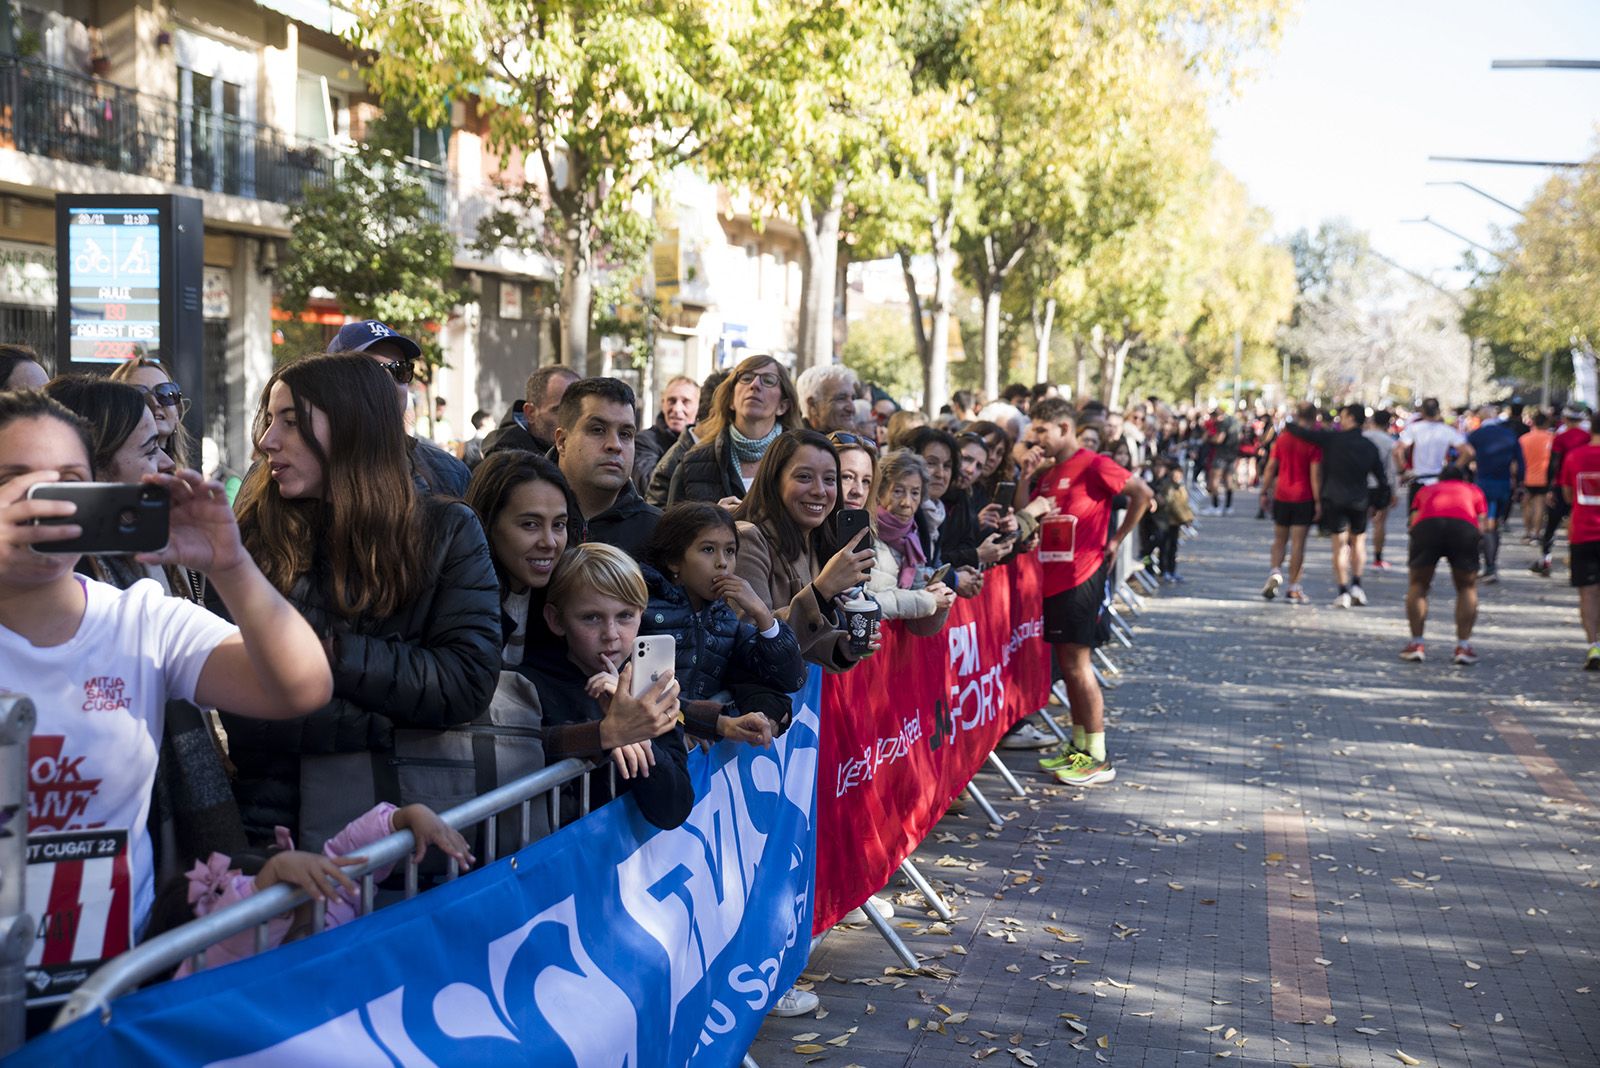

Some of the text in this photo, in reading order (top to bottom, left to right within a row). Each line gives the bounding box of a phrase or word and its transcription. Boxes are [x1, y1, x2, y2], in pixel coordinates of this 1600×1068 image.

[367, 322, 390, 336] LA
[84, 677, 125, 690] MITJA
[86, 688, 124, 699] SANT
[82, 698, 132, 711] CUGAT
[43, 839, 97, 857] CUGAT
[98, 838, 116, 853] 22
